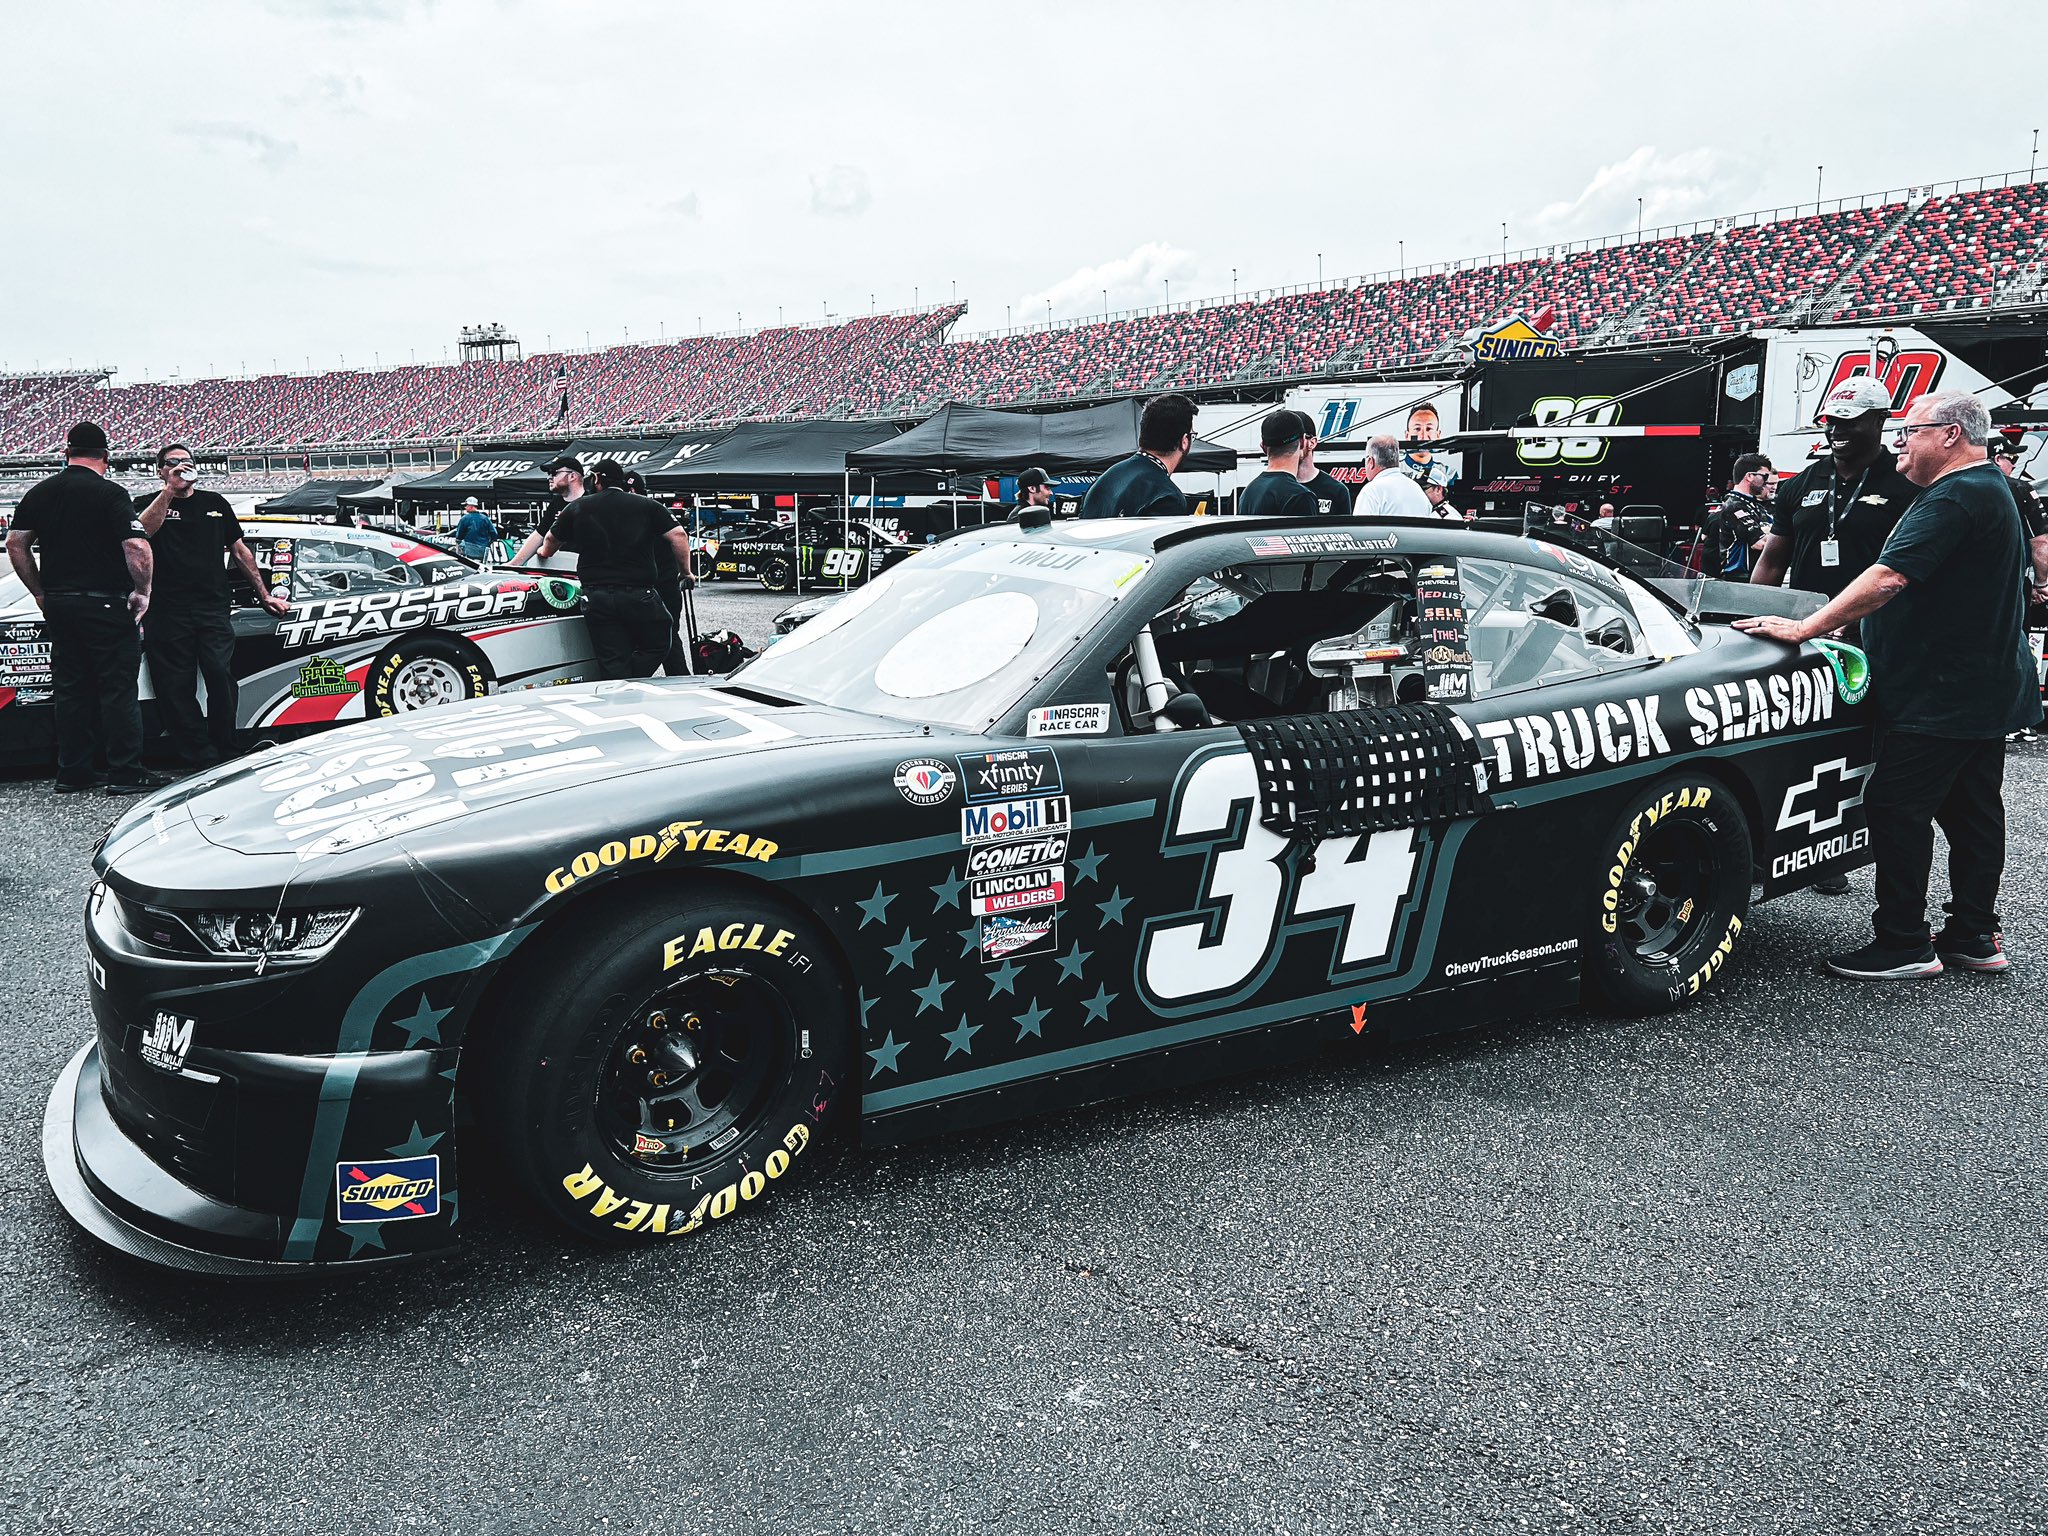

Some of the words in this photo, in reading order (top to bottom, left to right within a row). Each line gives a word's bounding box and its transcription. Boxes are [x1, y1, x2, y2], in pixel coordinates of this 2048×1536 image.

[1477, 338, 1557, 360] SUNOCO
[1319, 399, 1362, 441] 11
[449, 470, 517, 482] RACIN
[463, 460, 534, 473] KAULIG
[1061, 502, 1077, 513] 98
[732, 541, 785, 552] MONSTER
[1284, 533, 1353, 544] REMEMBERING
[1290, 542, 1324, 554] BUTCH
[1325, 539, 1391, 552] MCCALLISTER
[822, 549, 863, 578] 98
[1010, 551, 1087, 571] IWUJI
[292, 581, 501, 621] TROPHY
[279, 591, 527, 647] TRACTOR
[4, 628, 41, 639] xfinity
[0, 645, 34, 655] Mobil
[1, 673, 52, 684] COMETIC
[301, 665, 345, 685] PAGE
[292, 682, 360, 699] Construction
[1054, 707, 1099, 720] NASCAR
[1475, 694, 1671, 783] TRUCK
[1684, 665, 1834, 747] SEASON
[1039, 722, 1071, 732] RACE
[1075, 720, 1098, 730] CAR
[997, 751, 1028, 762] NASCAR
[978, 762, 1044, 790] xfinity
[903, 783, 951, 804] ANNIVERSARY
[1001, 783, 1028, 795] SERIES
[965, 802, 1038, 836] Mobil
[966, 834, 992, 843] OFFICIAL
[992, 831, 1015, 839] MOTOR
[1030, 823, 1067, 834] LUBRICANTS
[545, 821, 779, 894] GOODYEAR
[971, 838, 1065, 871] COMETIC
[1771, 826, 1869, 879] CHEVROLET
[977, 865, 1014, 876] GASKET
[1146, 752, 1416, 999] 34
[976, 871, 1048, 897] LINCOLN
[991, 888, 1056, 910] WELDERS
[982, 914, 1053, 941] Arrowhead
[662, 923, 796, 972] EAGLE
[1445, 938, 1579, 977] ChevyTruckSeason.com
[1688, 914, 1742, 996] EAGLE
[141, 1045, 162, 1059] JESSE
[161, 1053, 184, 1068] IWUJI
[638, 1140, 660, 1150] AERO
[344, 1179, 431, 1202] SUNOCO
[562, 1124, 810, 1236] GOODYEAR
